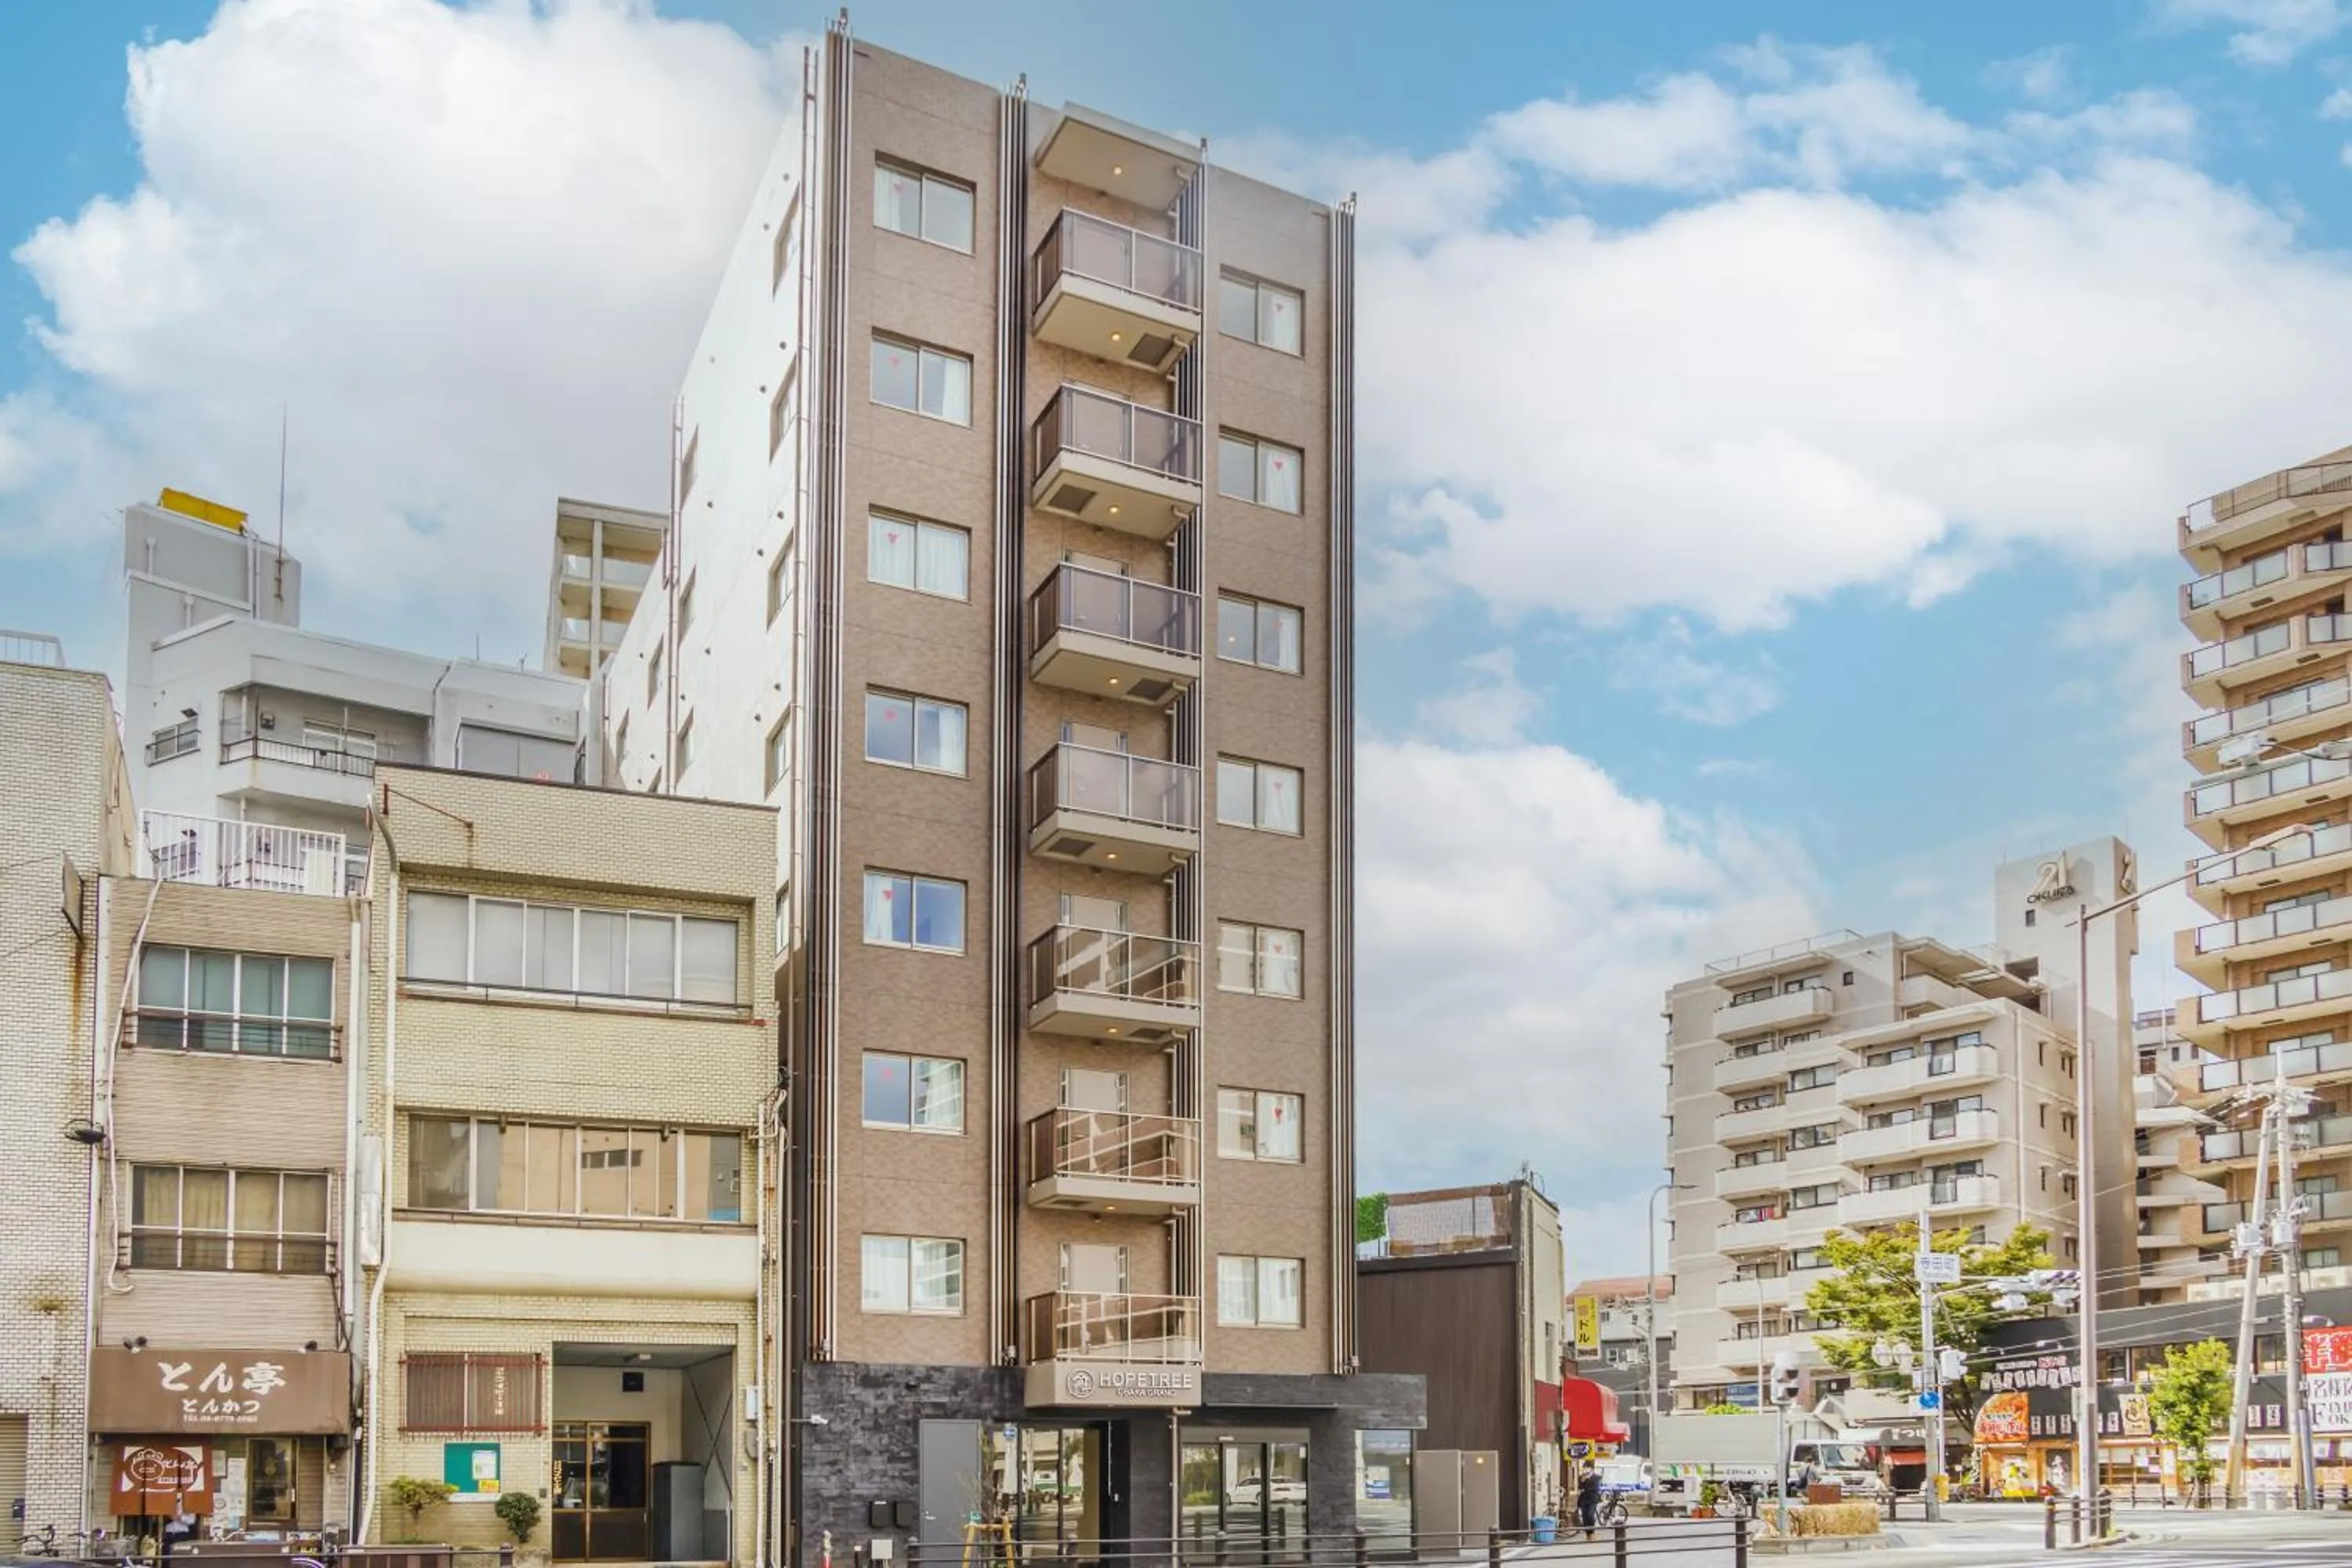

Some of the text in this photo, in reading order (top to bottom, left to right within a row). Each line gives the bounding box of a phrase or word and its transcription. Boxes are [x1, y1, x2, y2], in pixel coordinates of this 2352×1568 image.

[158, 1362, 287, 1395] とん亭
[1099, 1371, 1192, 1388] HOPETREE
[182, 1398, 261, 1414] とんかつ
